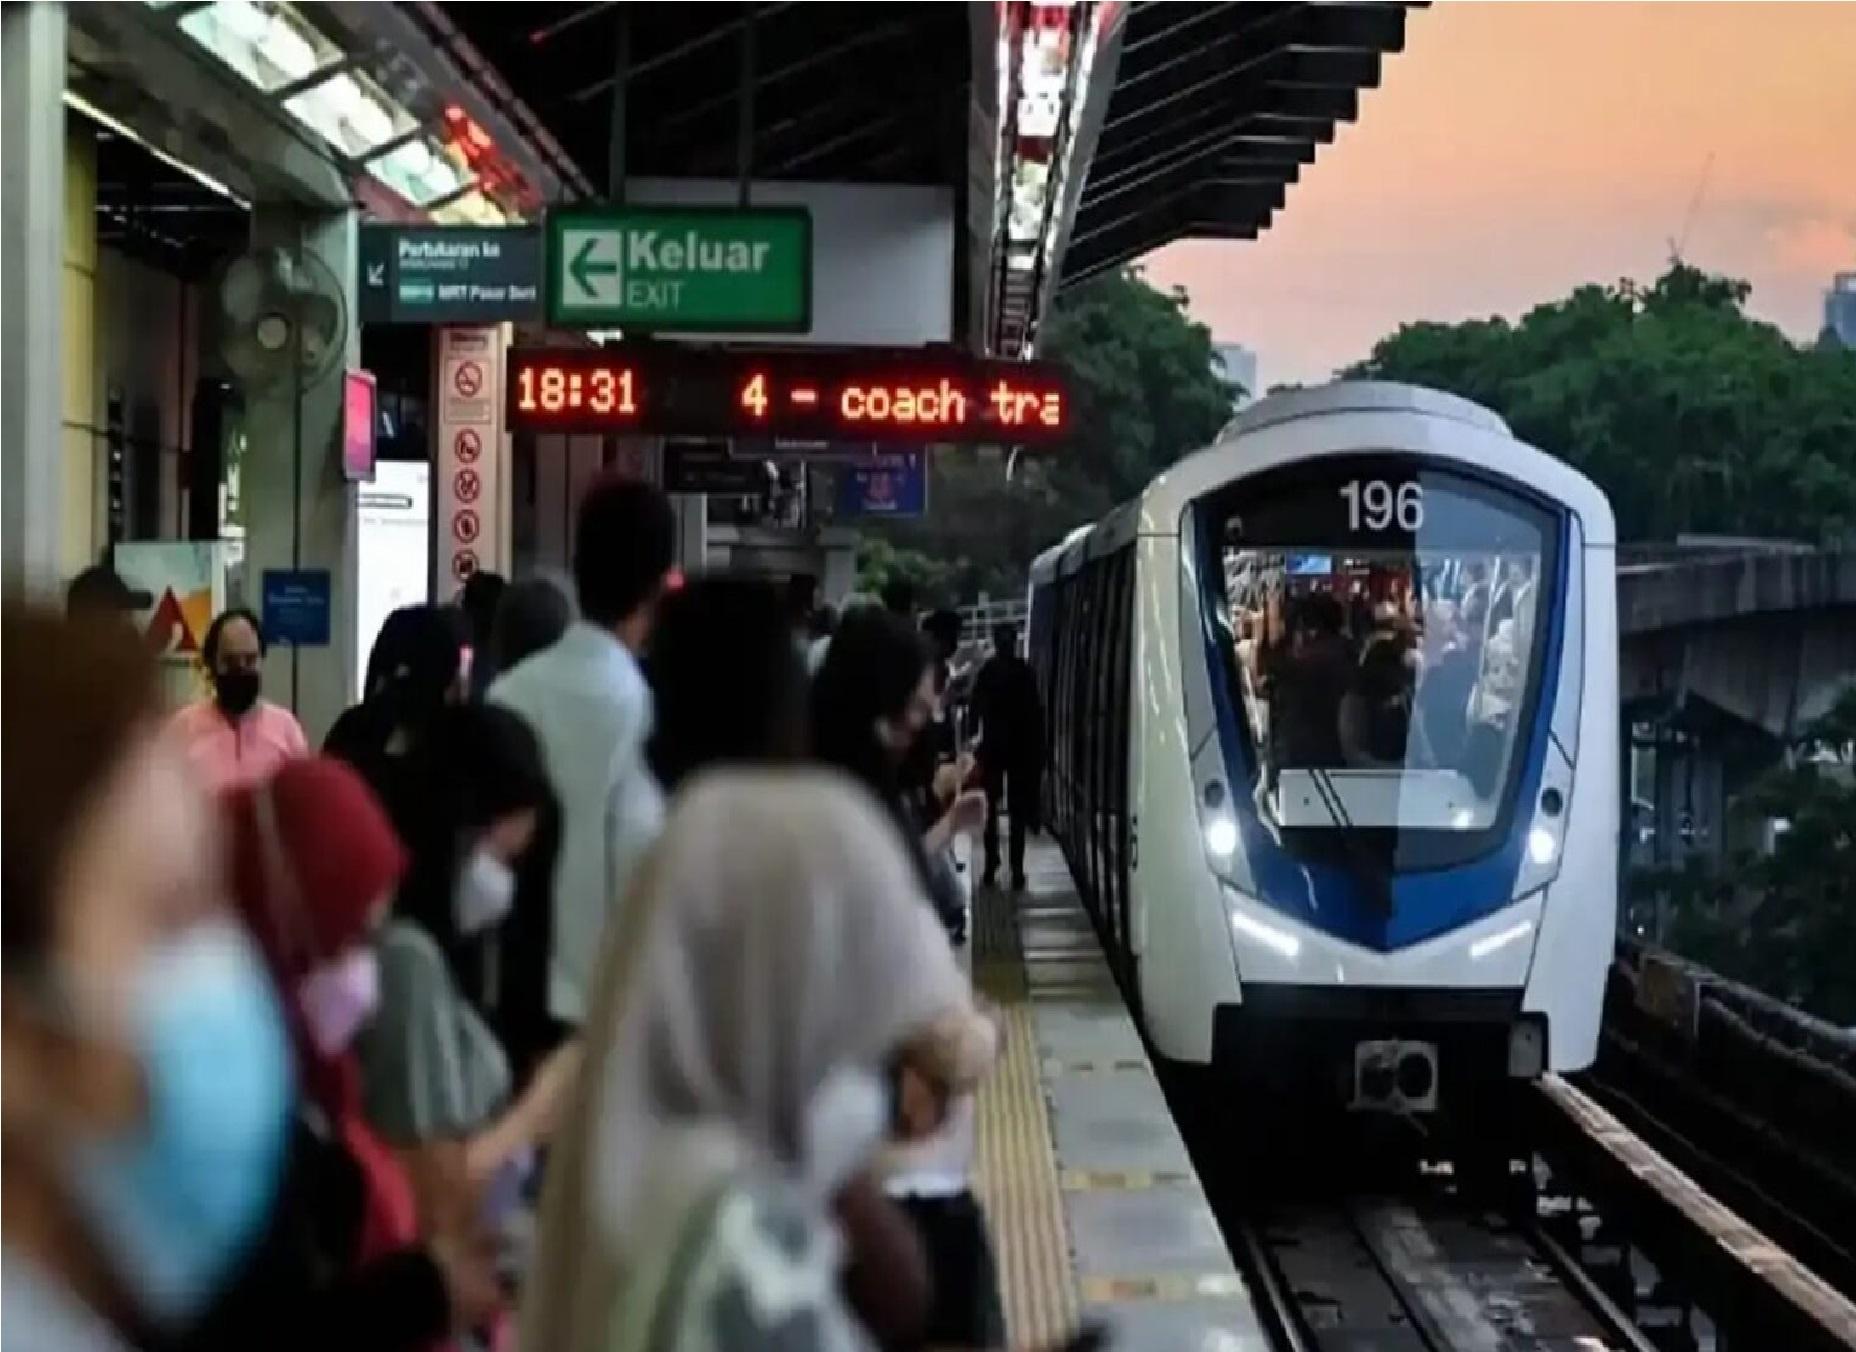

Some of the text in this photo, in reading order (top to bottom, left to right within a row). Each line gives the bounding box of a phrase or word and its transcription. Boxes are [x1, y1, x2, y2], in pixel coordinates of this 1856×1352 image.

[629, 231, 770, 273] Keluar
[628, 280, 685, 309] EXIT
[519, 367, 635, 415] 18:31
[742, 374, 768, 418] 4
[841, 378, 965, 424] coach
[990, 379, 1060, 426] tra
[1339, 480, 1424, 531] 196
